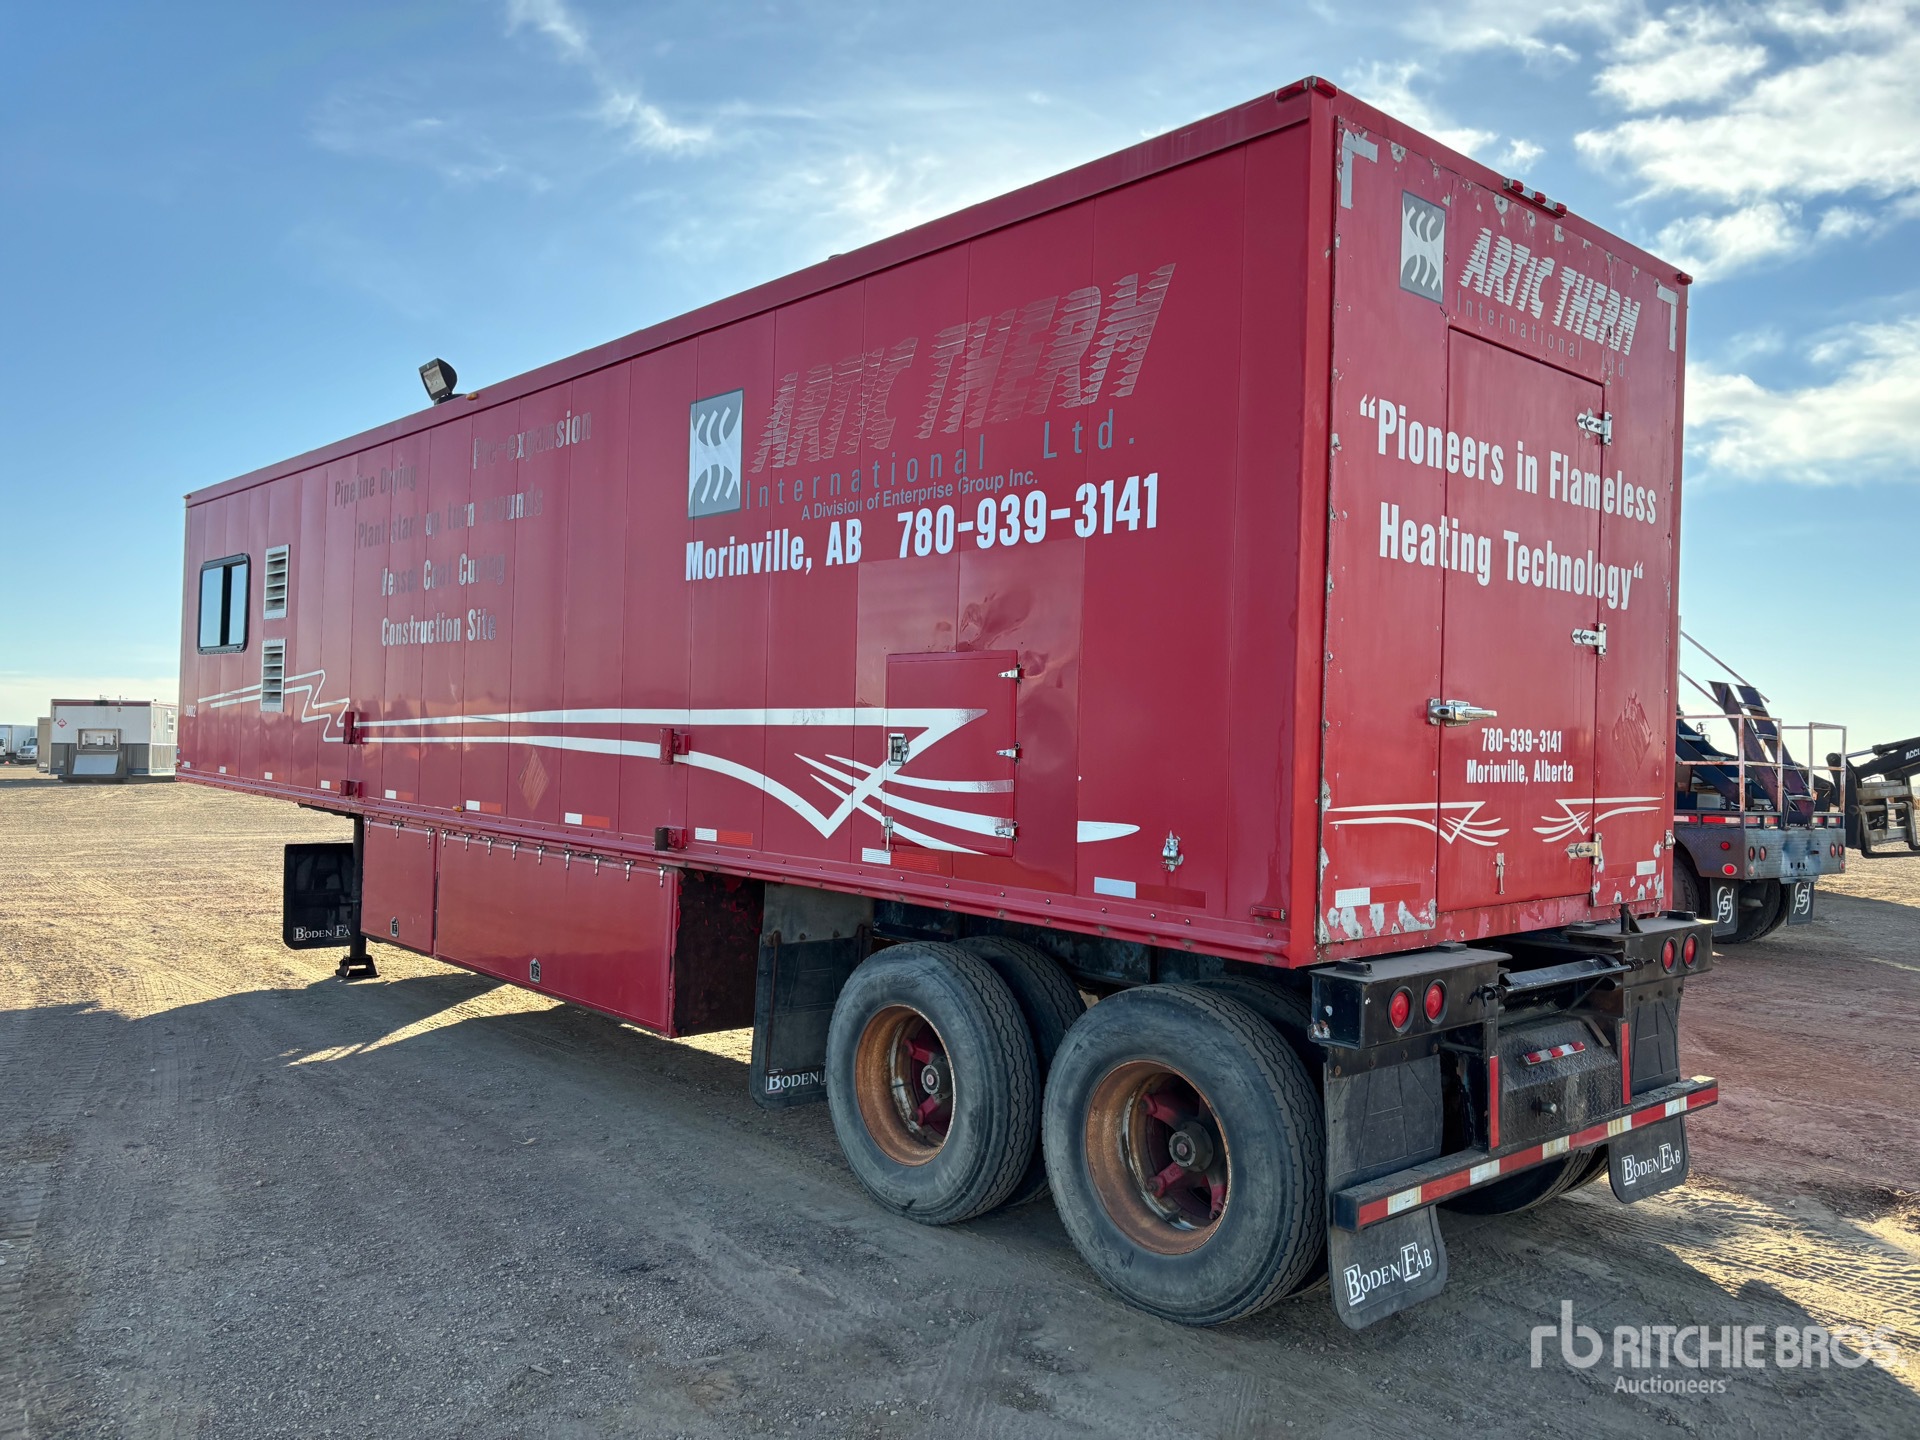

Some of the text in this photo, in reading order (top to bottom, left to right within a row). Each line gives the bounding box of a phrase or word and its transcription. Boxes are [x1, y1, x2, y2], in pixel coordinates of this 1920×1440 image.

[1456, 290, 1583, 361] International
[1457, 227, 1641, 356] ARTIC THERM
[746, 409, 1135, 510] International Ltd.
[801, 468, 1038, 521] A Division of Enterprise Group Inc.
[1516, 440, 1538, 494] in
[1549, 450, 1657, 525] Flameless
[685, 472, 1158, 582] Morinville, AB 780-939-3141
[1379, 501, 1492, 587] Heating
[381, 608, 497, 647] Construction Site
[1466, 759, 1574, 785] Morinville, Alberta
[1481, 728, 1562, 753] 780-939-3141
